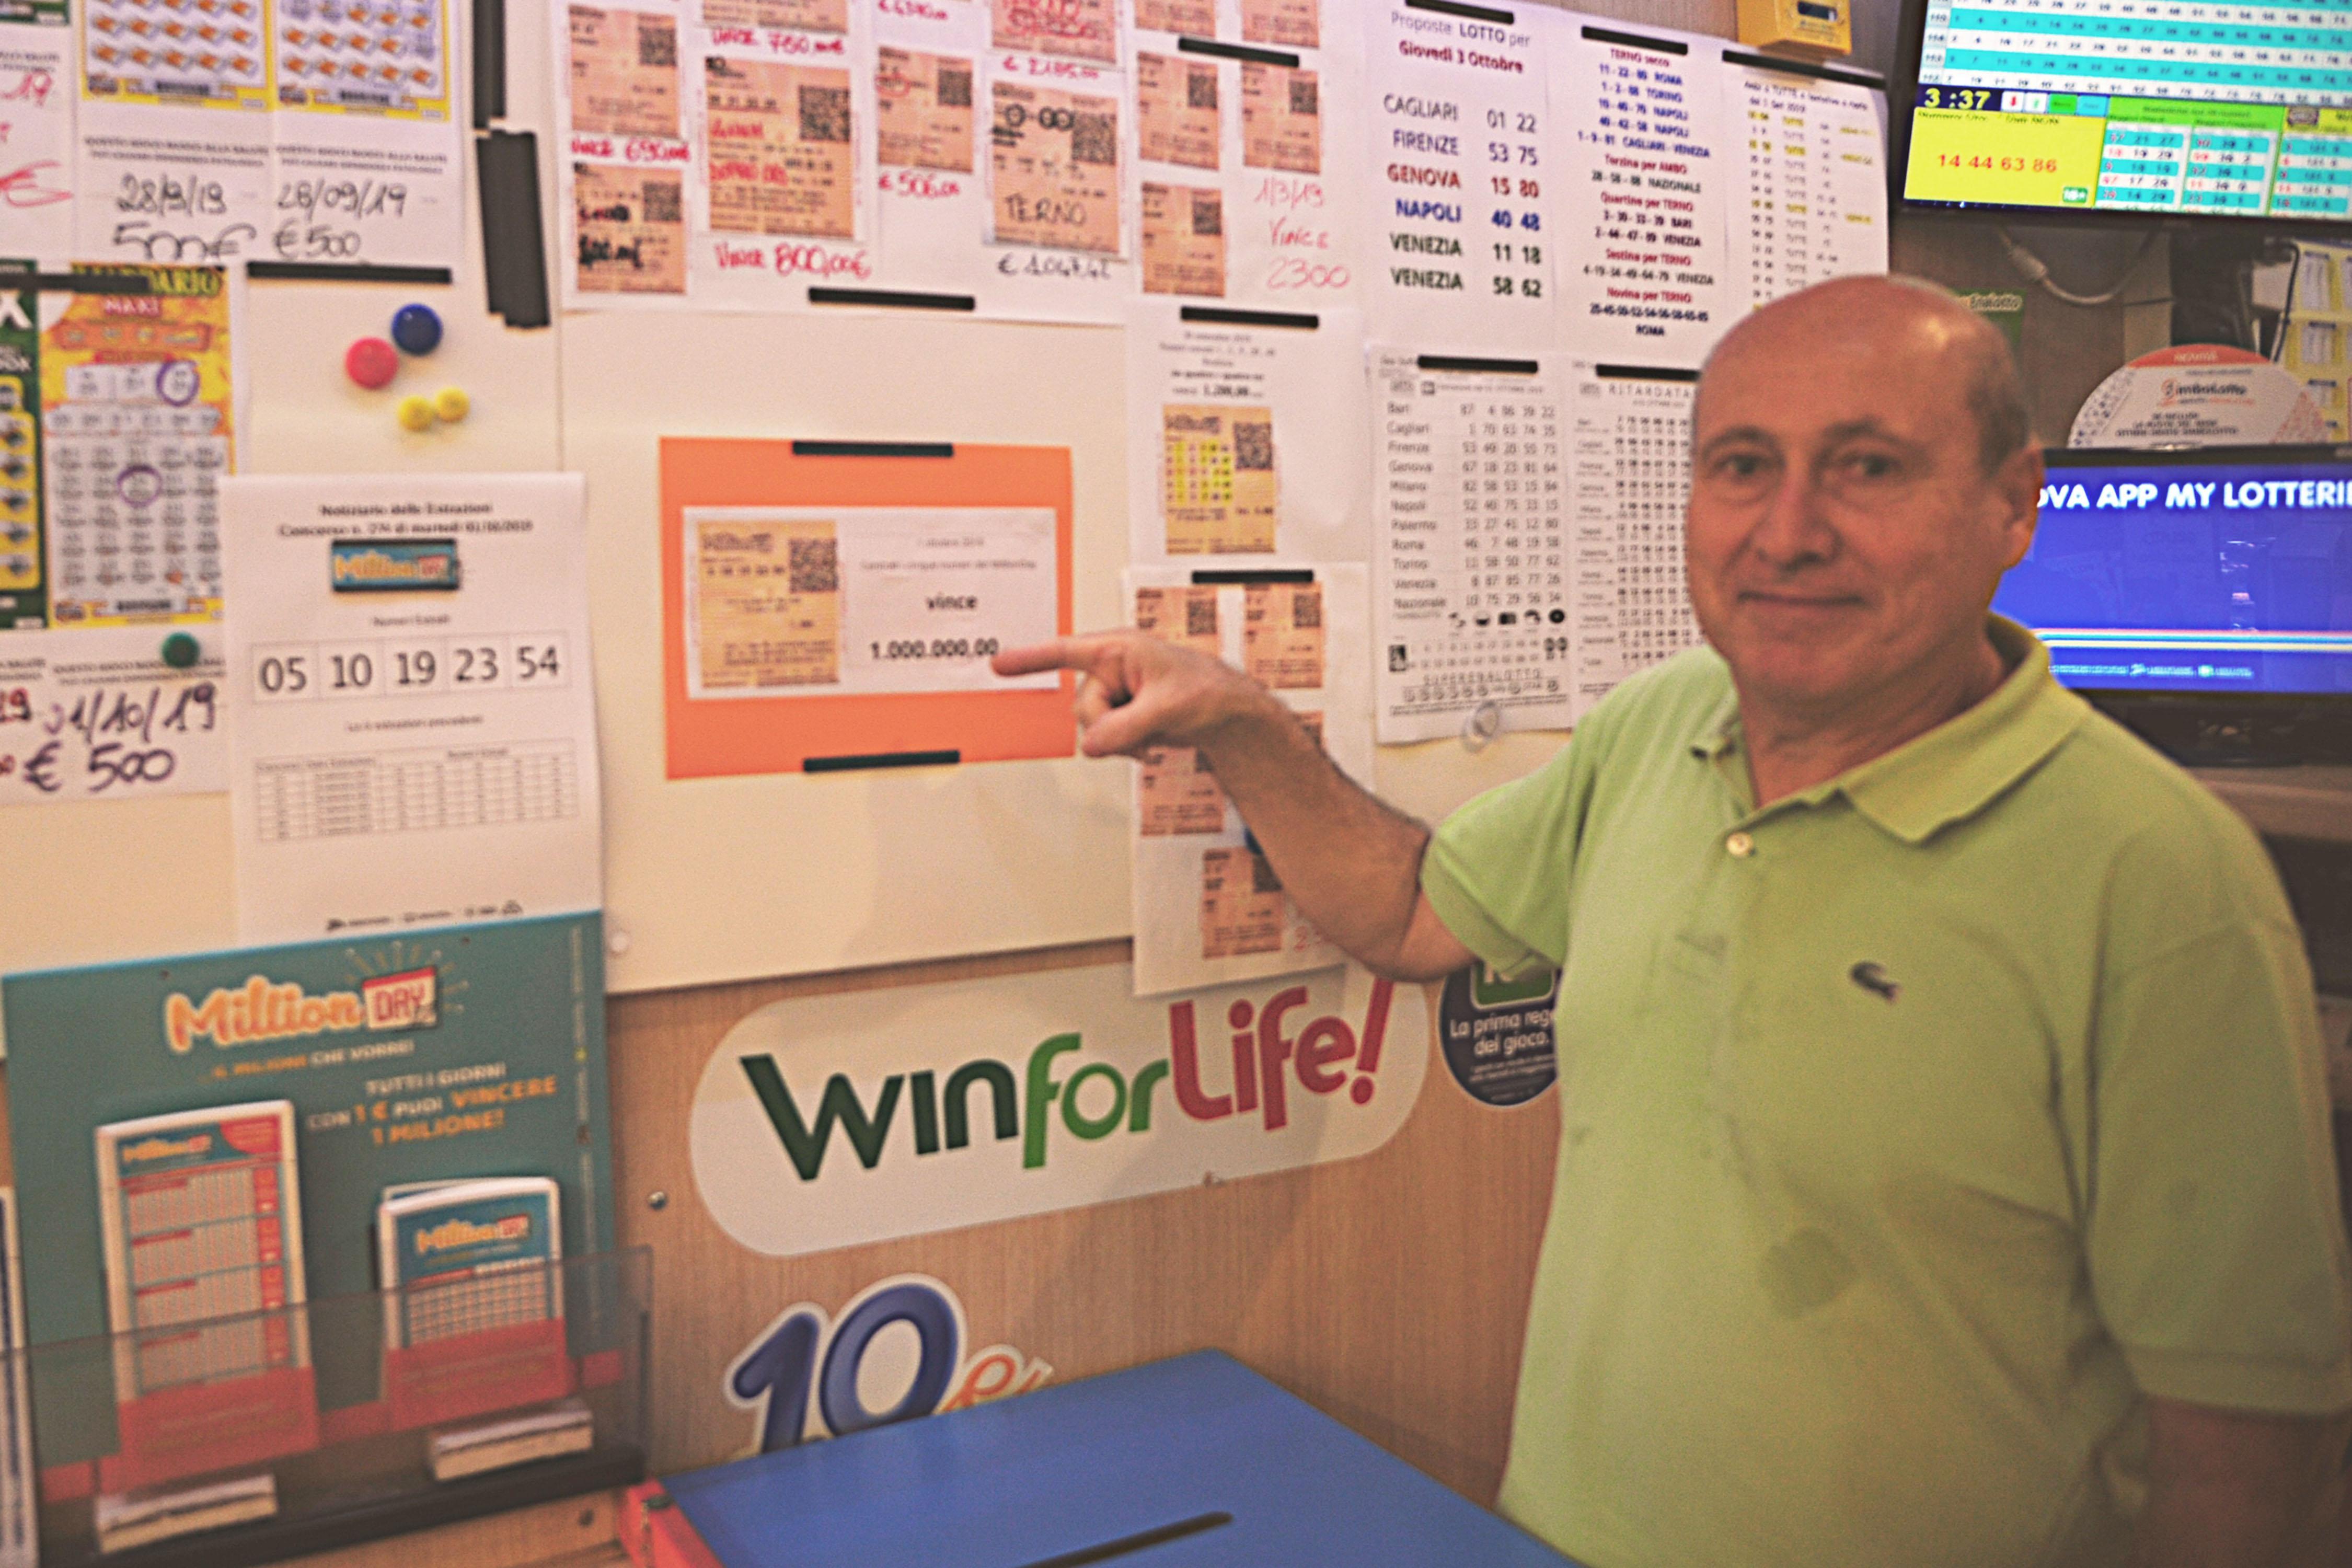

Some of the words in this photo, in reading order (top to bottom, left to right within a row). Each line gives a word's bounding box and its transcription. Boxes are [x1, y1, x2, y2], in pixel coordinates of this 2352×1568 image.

[1391, 11, 1451, 34] Proposte
[1460, 23, 1506, 43] LOTTO
[1509, 32, 1531, 47] per
[1468, 51, 1524, 73] Ottobre
[1611, 49, 1642, 63] TERNO
[1654, 72, 1683, 86] ROMA
[1646, 87, 1683, 103] TORINO
[1383, 93, 1459, 121] CAGLIARI
[1487, 109, 1506, 129] 01
[1517, 113, 1537, 133] 22
[1653, 106, 1689, 121] NAPOLI
[1654, 124, 1690, 139] NAPOLI
[1392, 129, 1460, 156] FIRENZE
[1489, 143, 1509, 163] 53
[1517, 146, 1538, 166] 75
[1622, 136, 1666, 152] CAGLIARI
[1673, 144, 1711, 158] VENEZIA
[1640, 160, 1657, 171] per
[1659, 162, 1688, 175] AMBO
[1938, 154, 1961, 168] 14
[1968, 155, 1993, 169] 44
[2001, 157, 2025, 171] 63
[2032, 158, 2058, 173] 86
[1387, 163, 1461, 189] GENOVA
[1491, 177, 1511, 197] 15
[1519, 179, 1540, 199] 80
[1648, 177, 1702, 194] NAZIONALE
[1005, 191, 1087, 226] TERNO
[1395, 199, 1461, 223] NAPOLI
[1492, 210, 1512, 229] 40
[1520, 213, 1541, 231] 48
[1645, 199, 1661, 210] per
[1663, 199, 1694, 212] TERNO
[1671, 217, 1692, 229] BARI
[305, 221, 361, 257] 500
[1389, 233, 1462, 257] VENEZIA
[1493, 244, 1512, 262] 11
[1521, 246, 1541, 264] 18
[1664, 234, 1702, 247] VENEZIA
[1643, 255, 1657, 265] per
[1661, 253, 1692, 266] TERNO
[1266, 258, 1351, 289] 2300
[1390, 267, 1465, 291] VENEZIA
[1492, 276, 1514, 296] 58
[1521, 279, 1542, 298] 62
[1676, 271, 1714, 285] VENEZIA
[1607, 287, 1641, 301] Novina
[1643, 292, 1658, 303] per
[1661, 290, 1692, 303] TERNO
[1635, 324, 1665, 336] ROMA
[1609, 384, 1690, 397] RITARDATA
[2096, 483, 2158, 509] APP
[2165, 482, 2216, 509] MY
[1392, 538, 1424, 550] Roma
[926, 593, 978, 610] vince
[260, 655, 308, 693] 05
[330, 652, 373, 689] 10
[395, 649, 437, 686] 19
[453, 646, 499, 683] 23
[517, 644, 560, 679] 54
[24, 740, 63, 792] €
[88, 742, 176, 793] 500
[166, 974, 362, 1054] Million
[372, 983, 426, 1023] DAY
[1449, 1019, 1470, 1039] La
[1473, 1012, 1521, 1038] prima
[1524, 1008, 1553, 1028] reg
[1473, 1035, 1499, 1056] del
[1503, 1030, 1551, 1057] gioco.
[366, 1073, 422, 1095] TUTTI
[436, 1061, 507, 1086] GIORNI
[306, 1109, 352, 1131] CON
[392, 1096, 444, 1119] PUOI
[451, 1074, 558, 1109] VINCERE
[732, 1281, 960, 1457] 10
